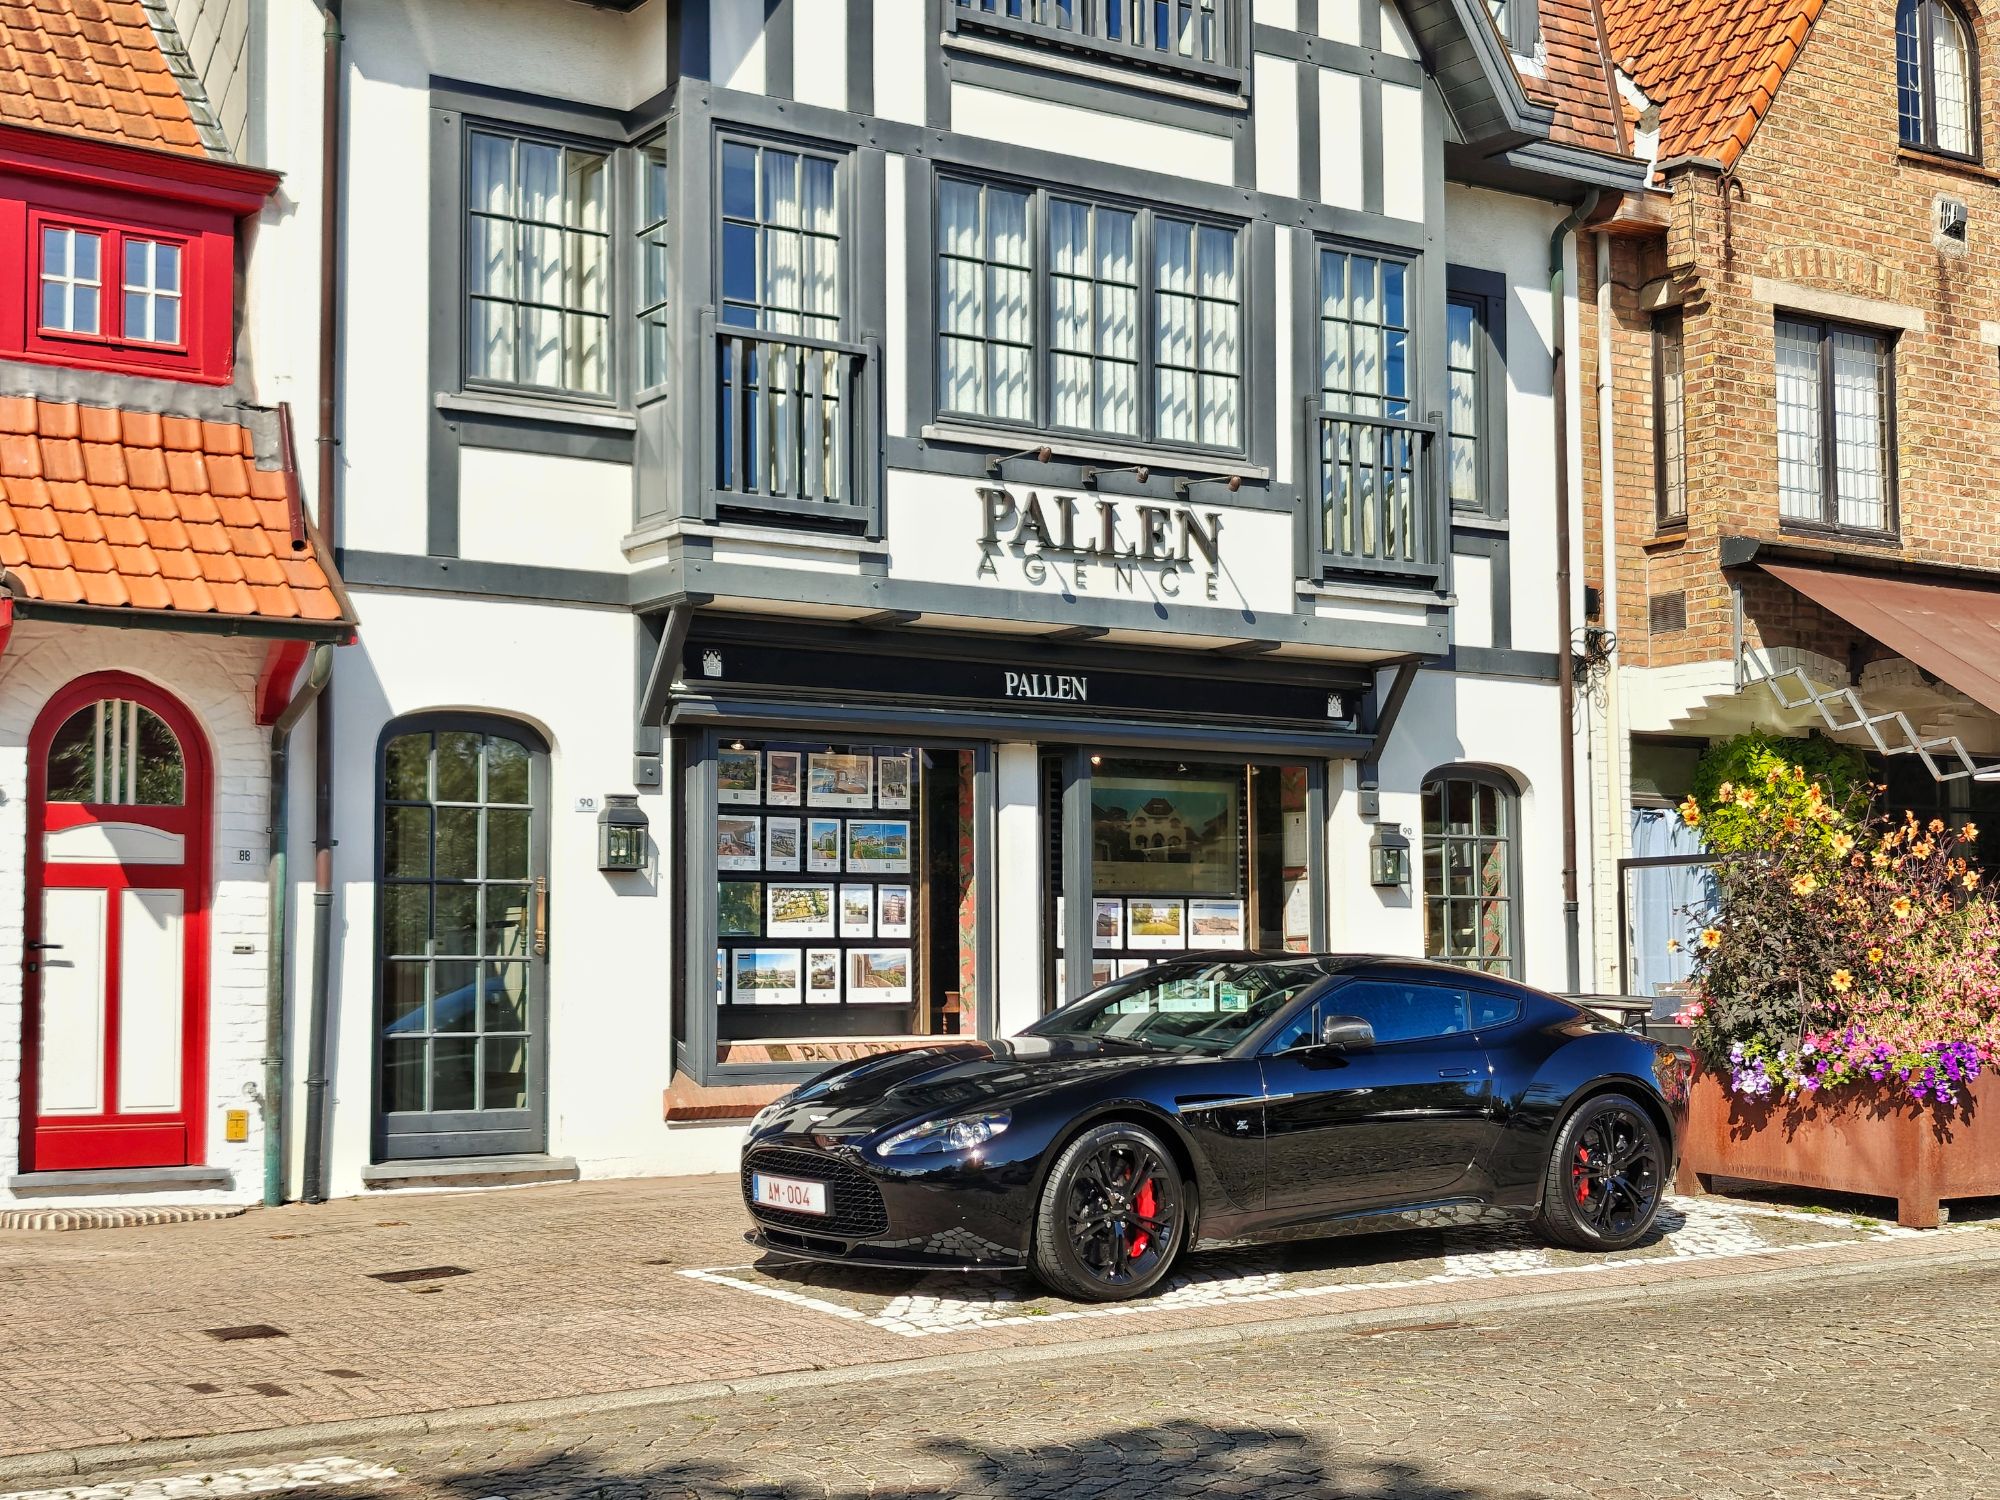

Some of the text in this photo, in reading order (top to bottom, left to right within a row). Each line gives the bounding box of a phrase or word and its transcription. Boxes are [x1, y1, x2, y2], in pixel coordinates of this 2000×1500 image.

[975, 487, 1222, 571] PALLEN
[976, 549, 1218, 600] AGENCE
[1004, 671, 1088, 701] PALLEN
[579, 798, 593, 807] 90
[1402, 827, 1412, 835] 90
[239, 849, 251, 861] 88
